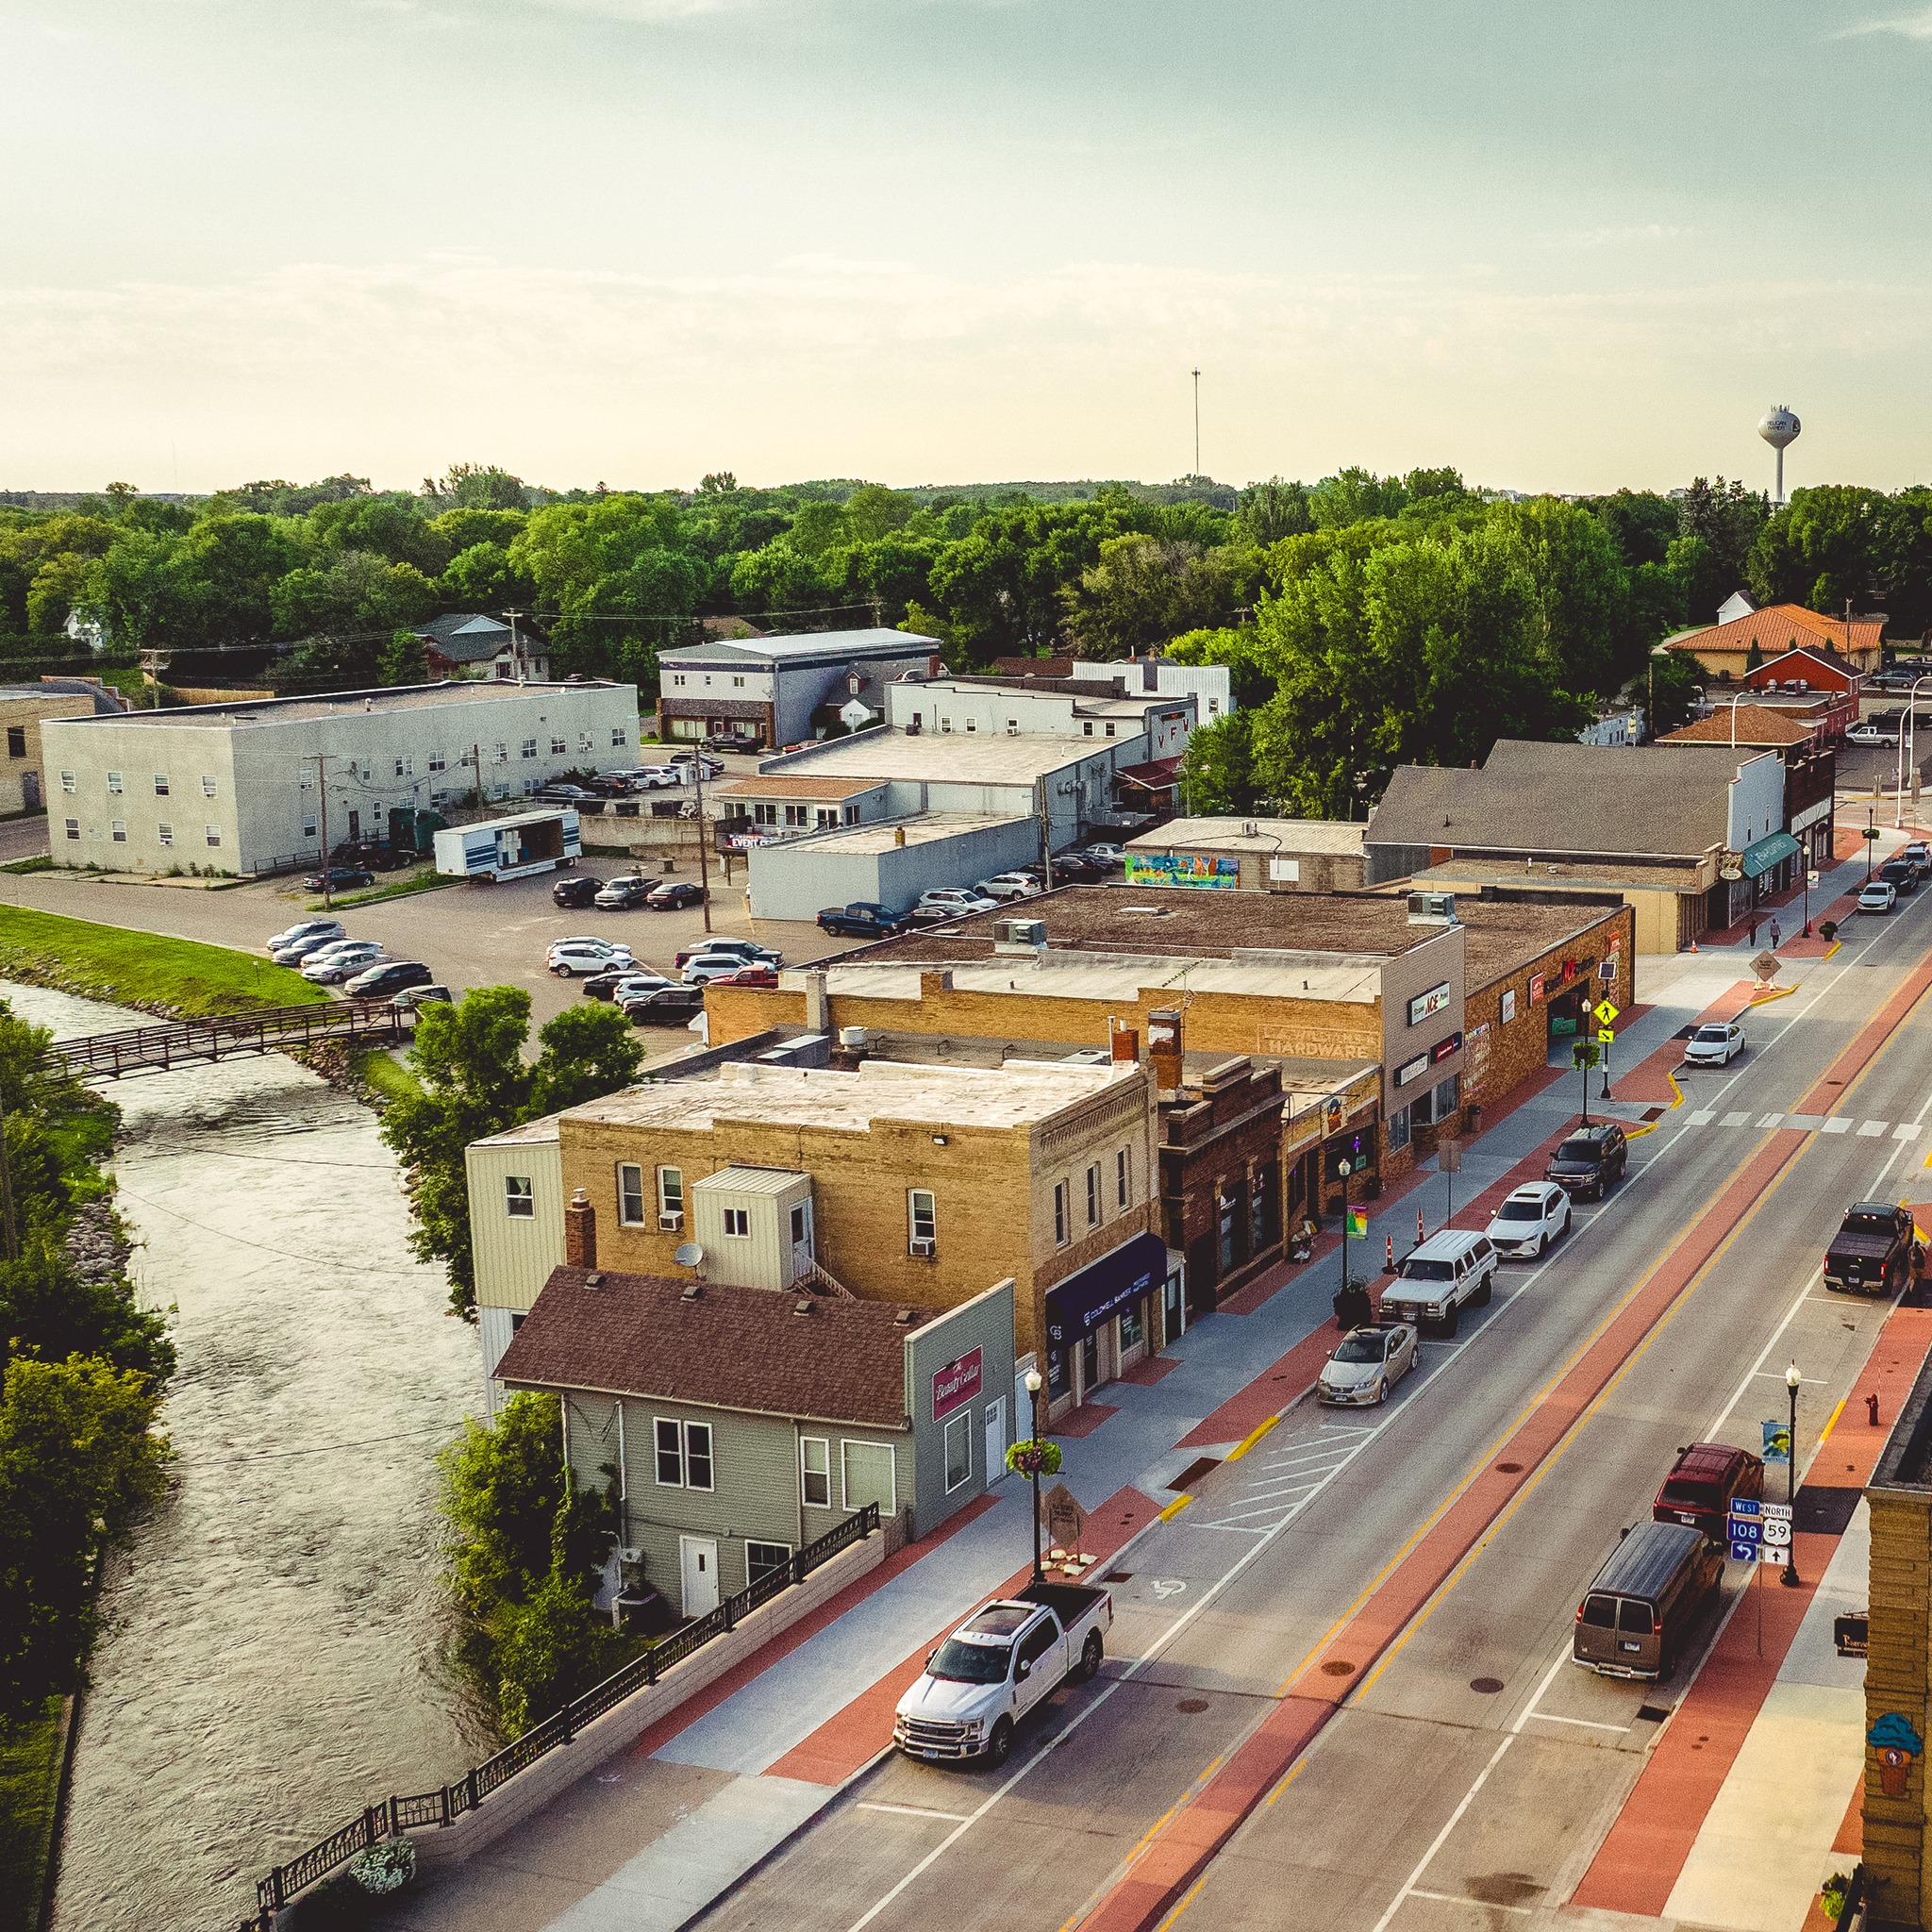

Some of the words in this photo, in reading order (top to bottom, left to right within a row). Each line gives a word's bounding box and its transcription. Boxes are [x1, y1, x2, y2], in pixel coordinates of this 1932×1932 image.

[732, 838, 758, 848] EVENT
[1269, 1040, 1369, 1058] HARDWARE
[936, 1376, 960, 1401] Beauty
[959, 1364, 981, 1385] Cellar
[1735, 1501, 1756, 1513] WEST
[1764, 1505, 1790, 1518] NORTH
[1732, 1523, 1757, 1539] 108
[1768, 1524, 1787, 1539] 59
